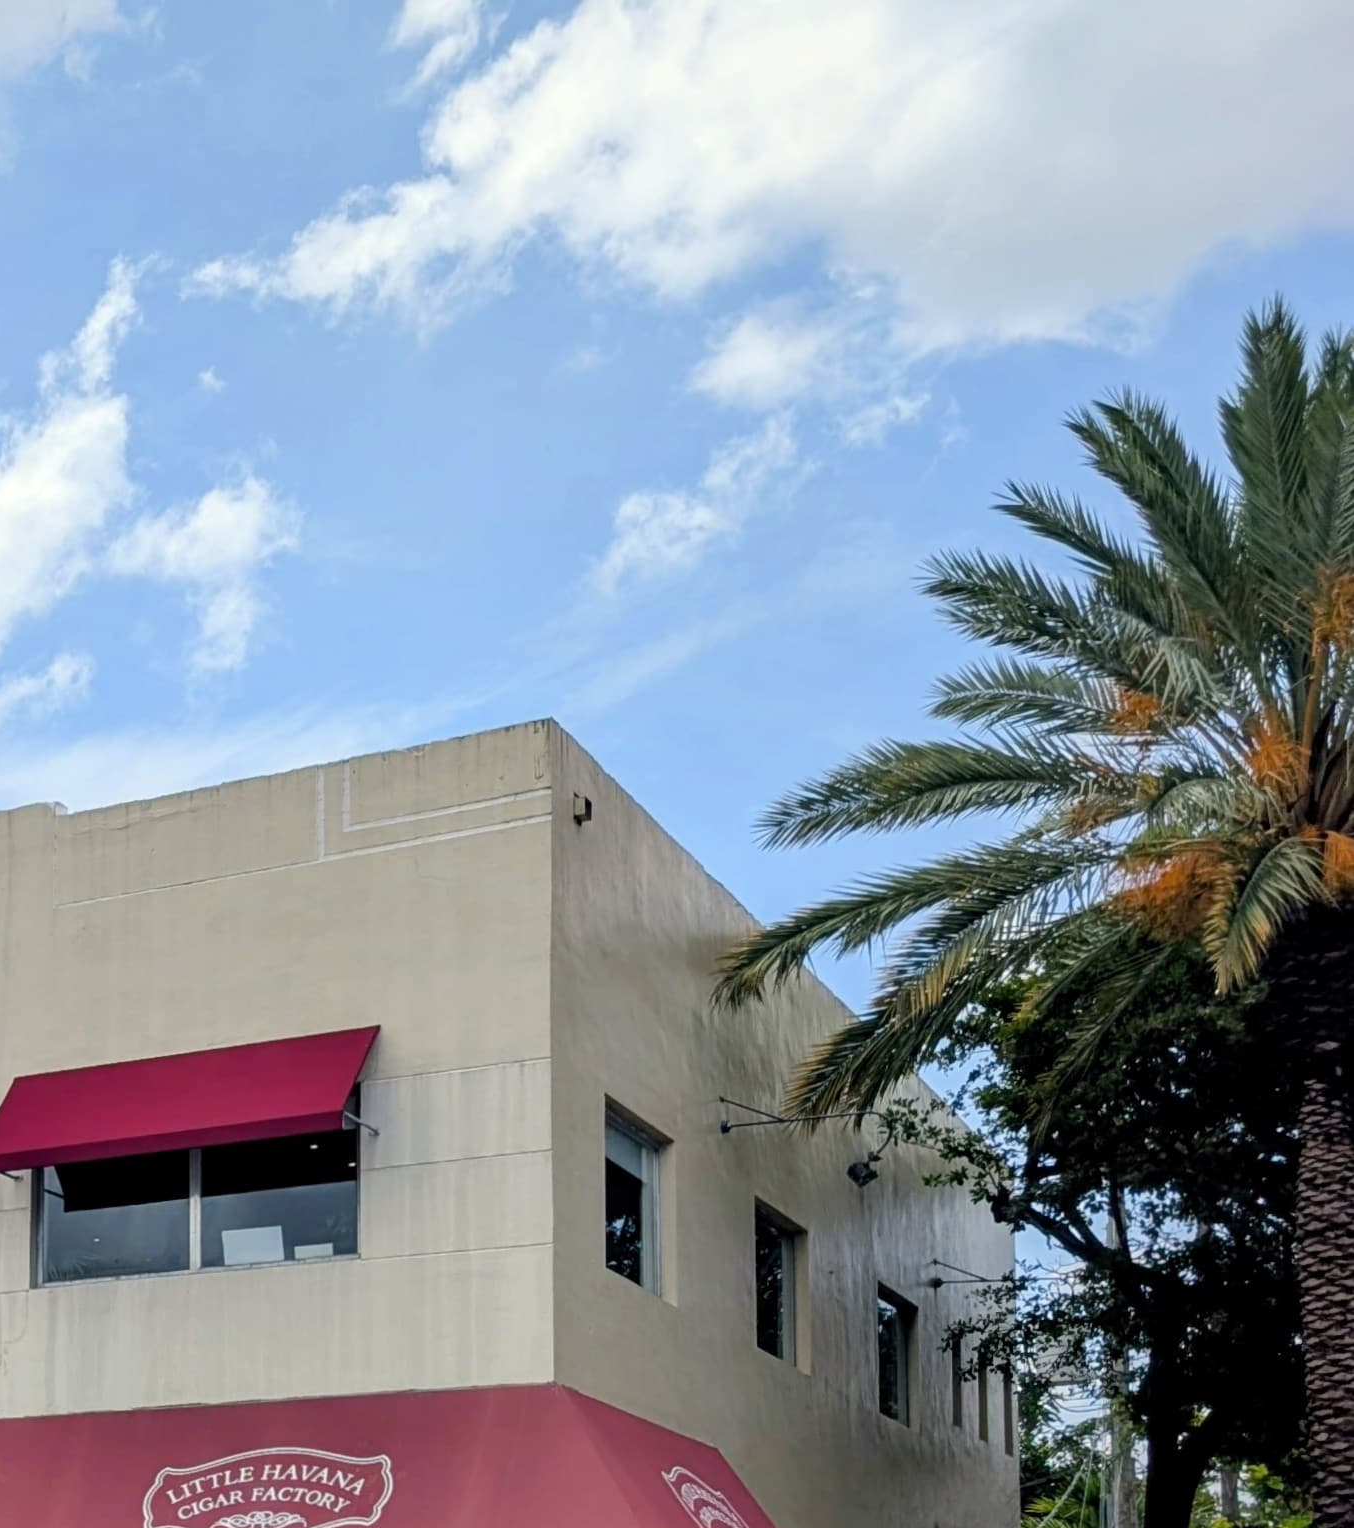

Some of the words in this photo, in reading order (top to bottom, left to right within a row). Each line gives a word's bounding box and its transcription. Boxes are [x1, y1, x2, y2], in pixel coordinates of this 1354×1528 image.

[165, 1466, 255, 1505] LITTLE
[260, 1464, 366, 1496] HAVANA
[177, 1489, 245, 1520] CIGAR
[250, 1486, 352, 1514] FACTORY
